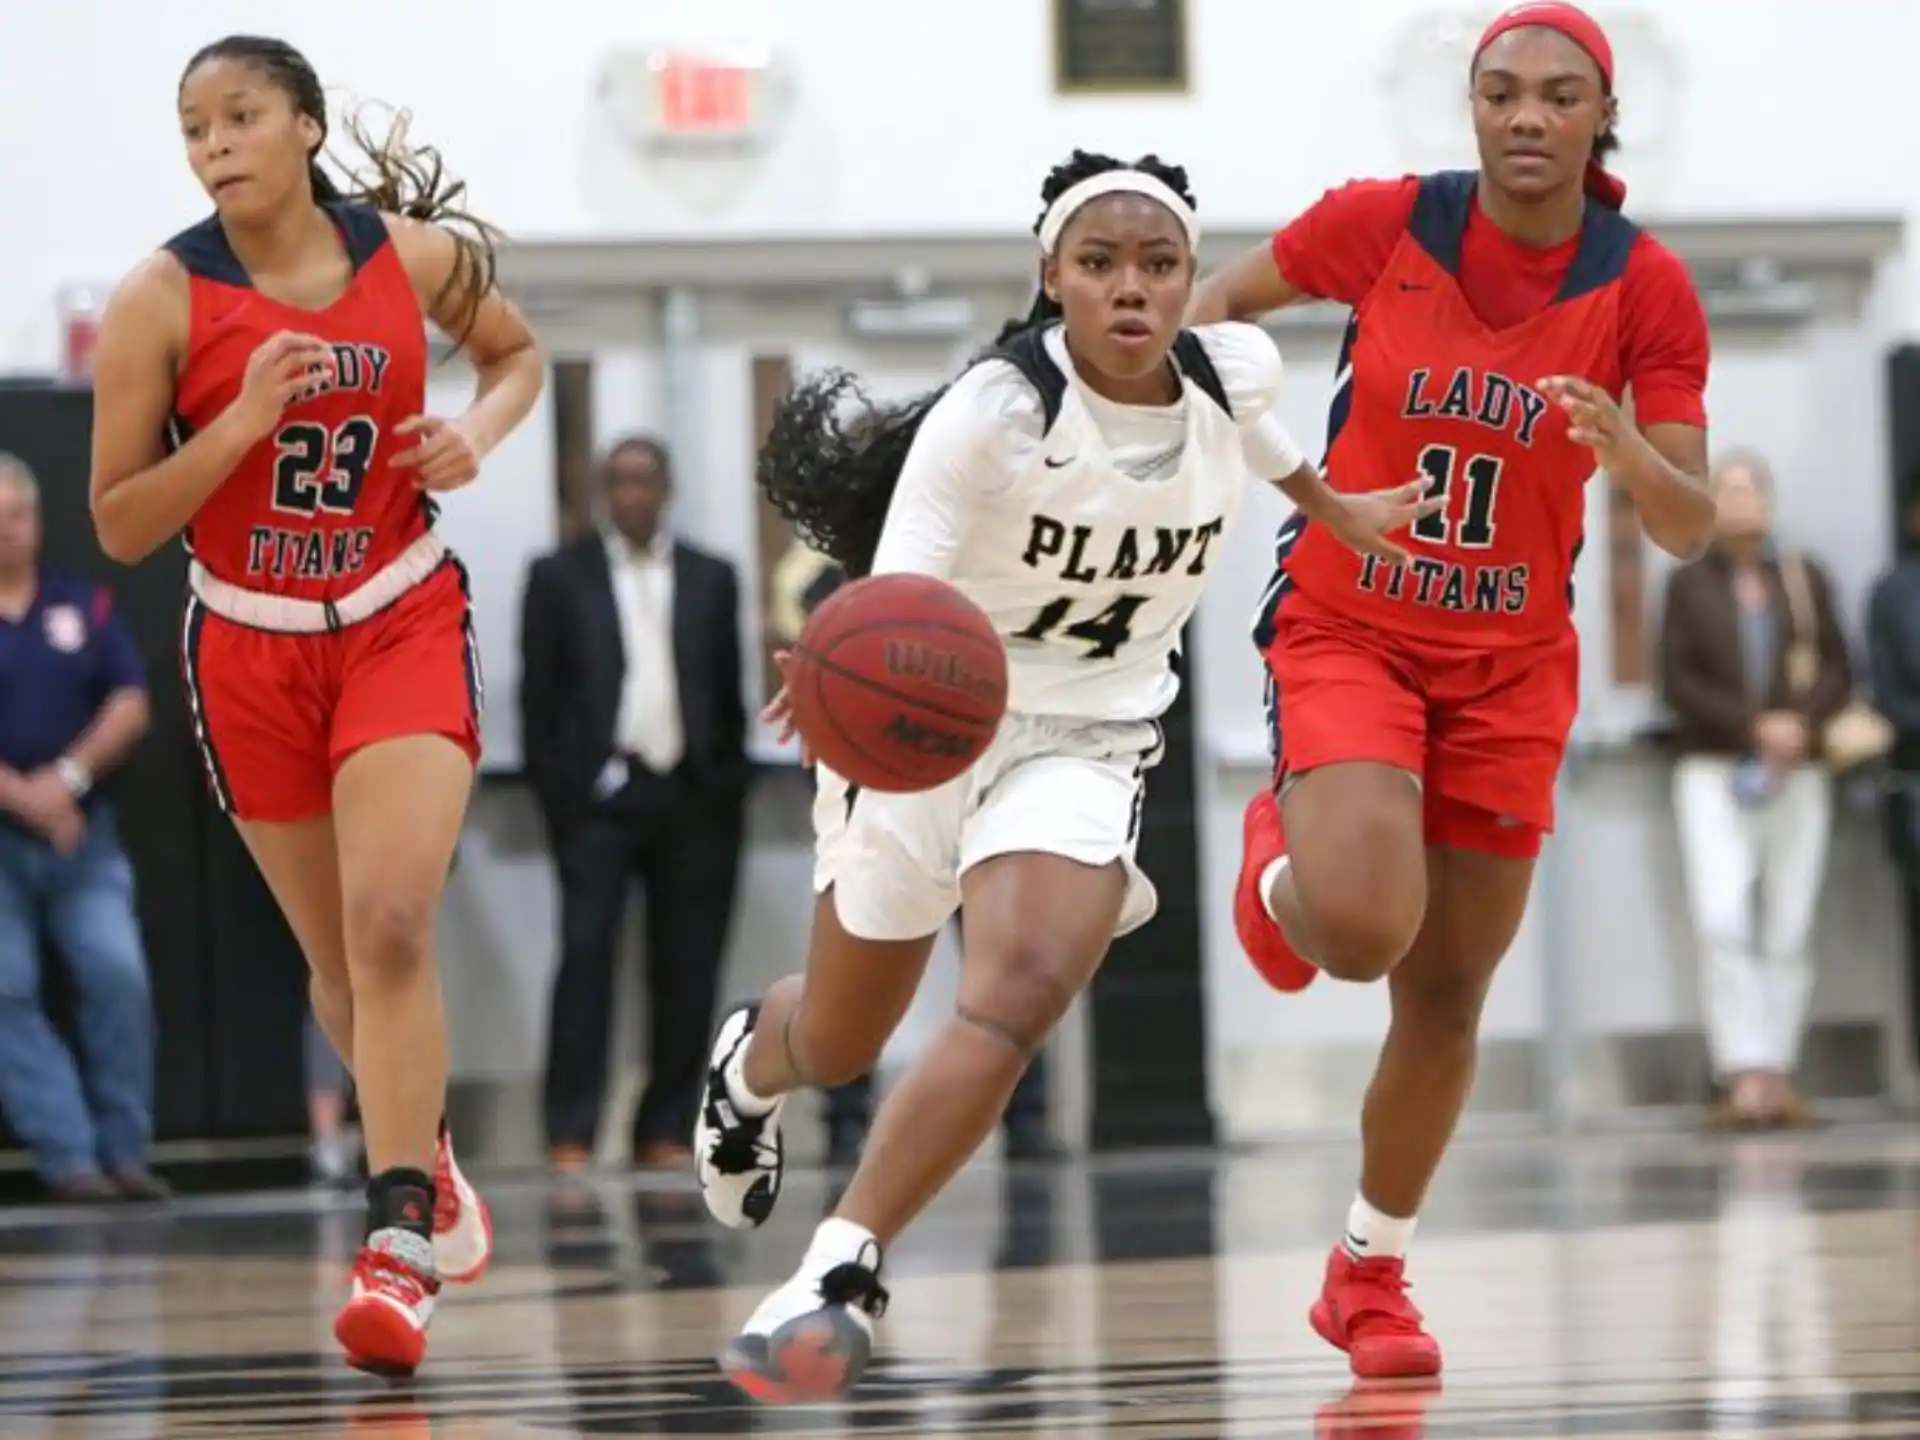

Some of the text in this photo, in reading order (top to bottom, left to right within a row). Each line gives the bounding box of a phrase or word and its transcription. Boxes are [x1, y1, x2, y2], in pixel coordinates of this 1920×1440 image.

[284, 342, 390, 406] DY
[1402, 366, 1547, 448] LADY
[271, 414, 379, 519] 23
[1409, 443, 1504, 549] 11
[1021, 513, 1224, 584] PLANT
[1356, 551, 1530, 615] TITANS
[1009, 594, 1152, 660] 14
